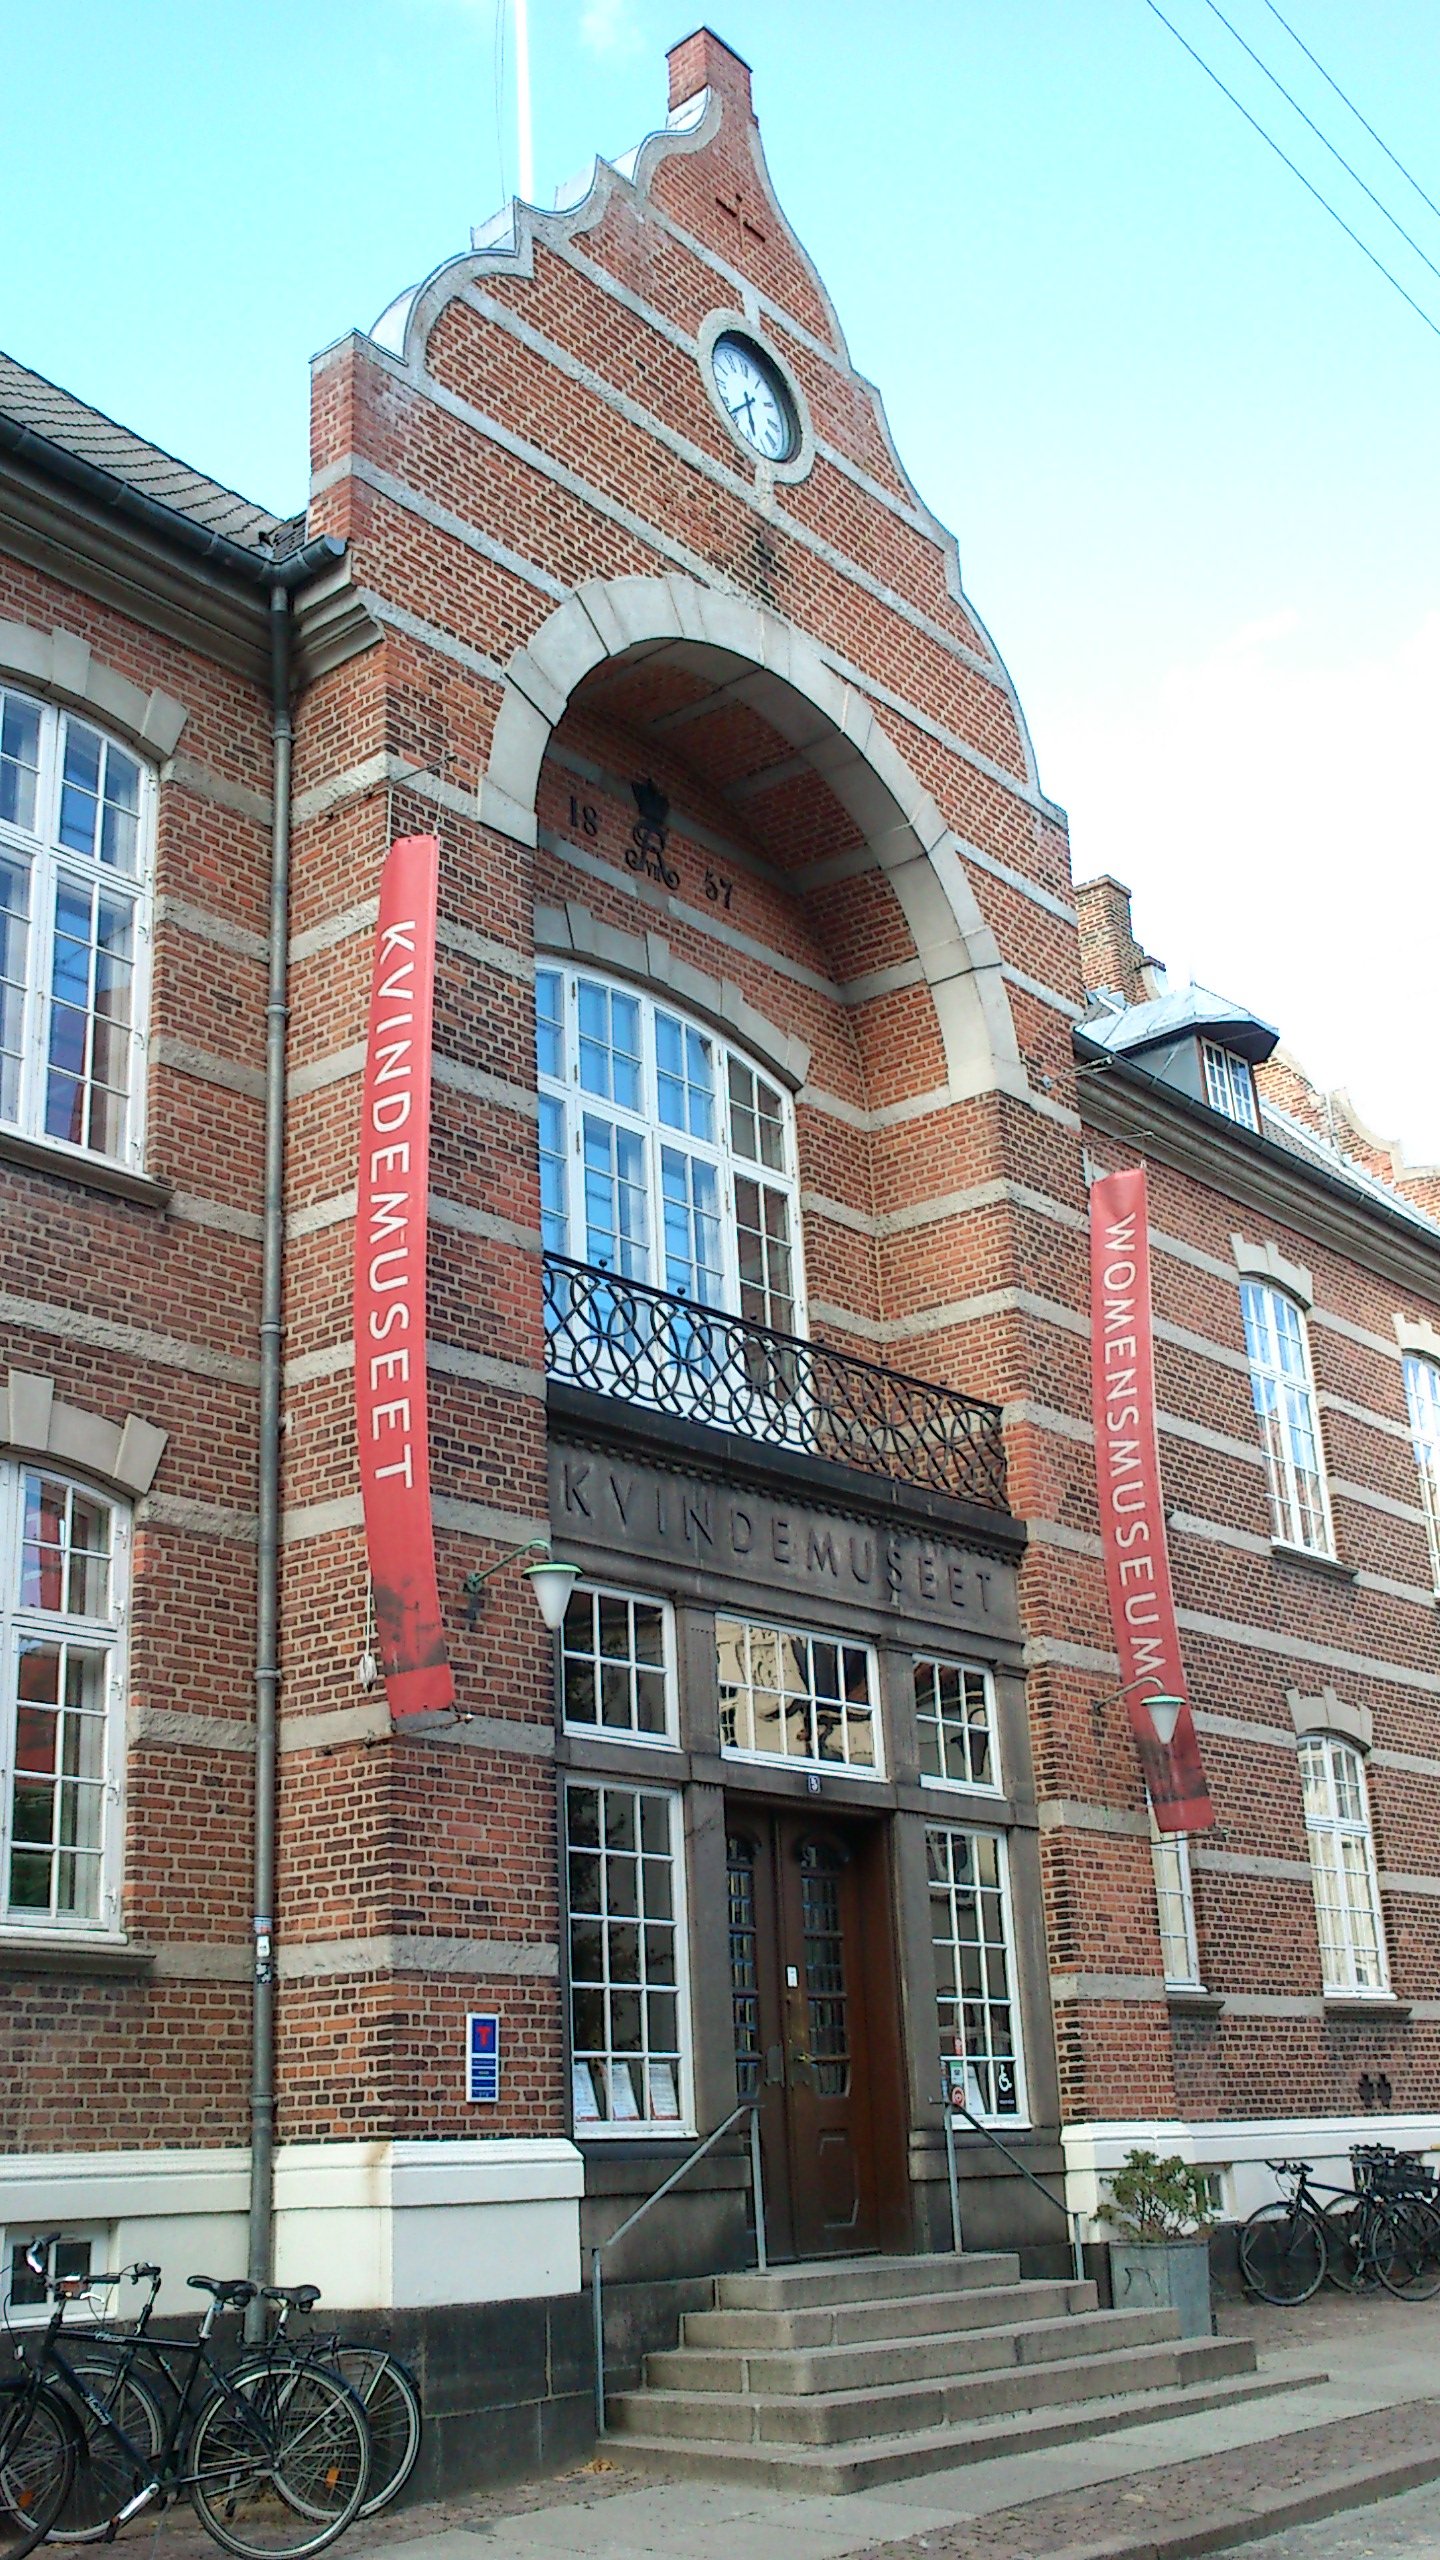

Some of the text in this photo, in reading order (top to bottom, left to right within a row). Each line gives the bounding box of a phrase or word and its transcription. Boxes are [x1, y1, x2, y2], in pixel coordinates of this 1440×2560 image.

[368, 920, 416, 1489] KVINDEMUSEET
[561, 1463, 992, 1613] KVINDEMUSEET
[1103, 1211, 1167, 1677] WOMENSMUSEUM
